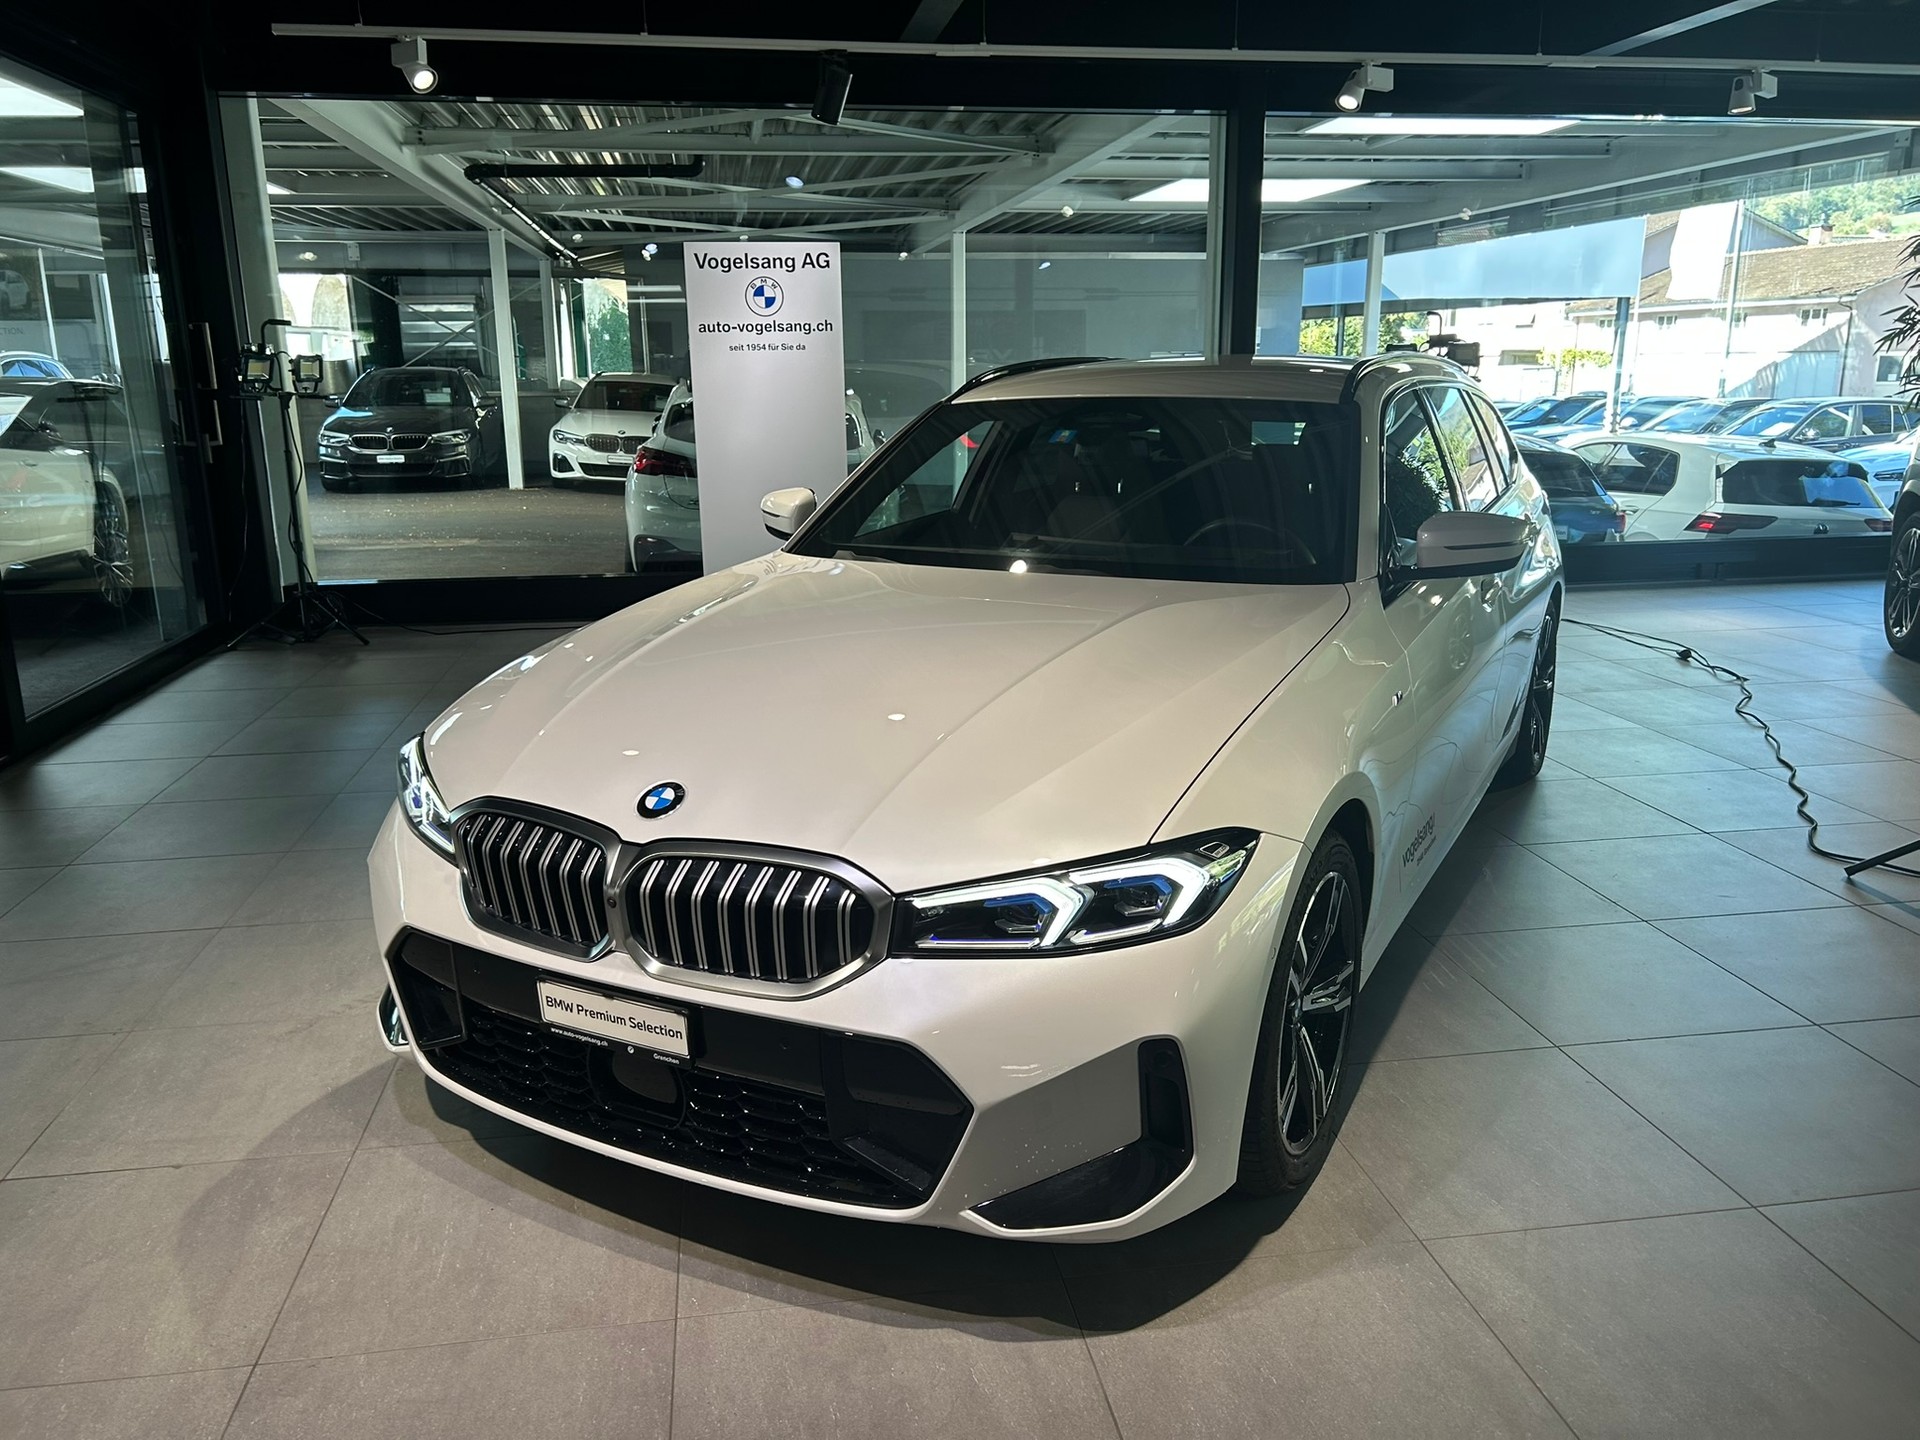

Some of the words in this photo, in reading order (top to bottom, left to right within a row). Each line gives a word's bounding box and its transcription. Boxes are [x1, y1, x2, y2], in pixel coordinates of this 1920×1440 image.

[694, 252, 796, 273] Vogelsang
[801, 252, 831, 269] AG
[750, 278, 778, 290] BMW
[698, 319, 833, 335] auto-vogelsang.ch
[729, 343, 744, 351] seit
[746, 343, 767, 351] 1954
[768, 343, 779, 351] für
[781, 343, 794, 351] Sie
[795, 343, 806, 351] da
[545, 995, 574, 1014] BMW
[576, 1004, 626, 1026] Premium
[629, 1016, 683, 1040] Selection
